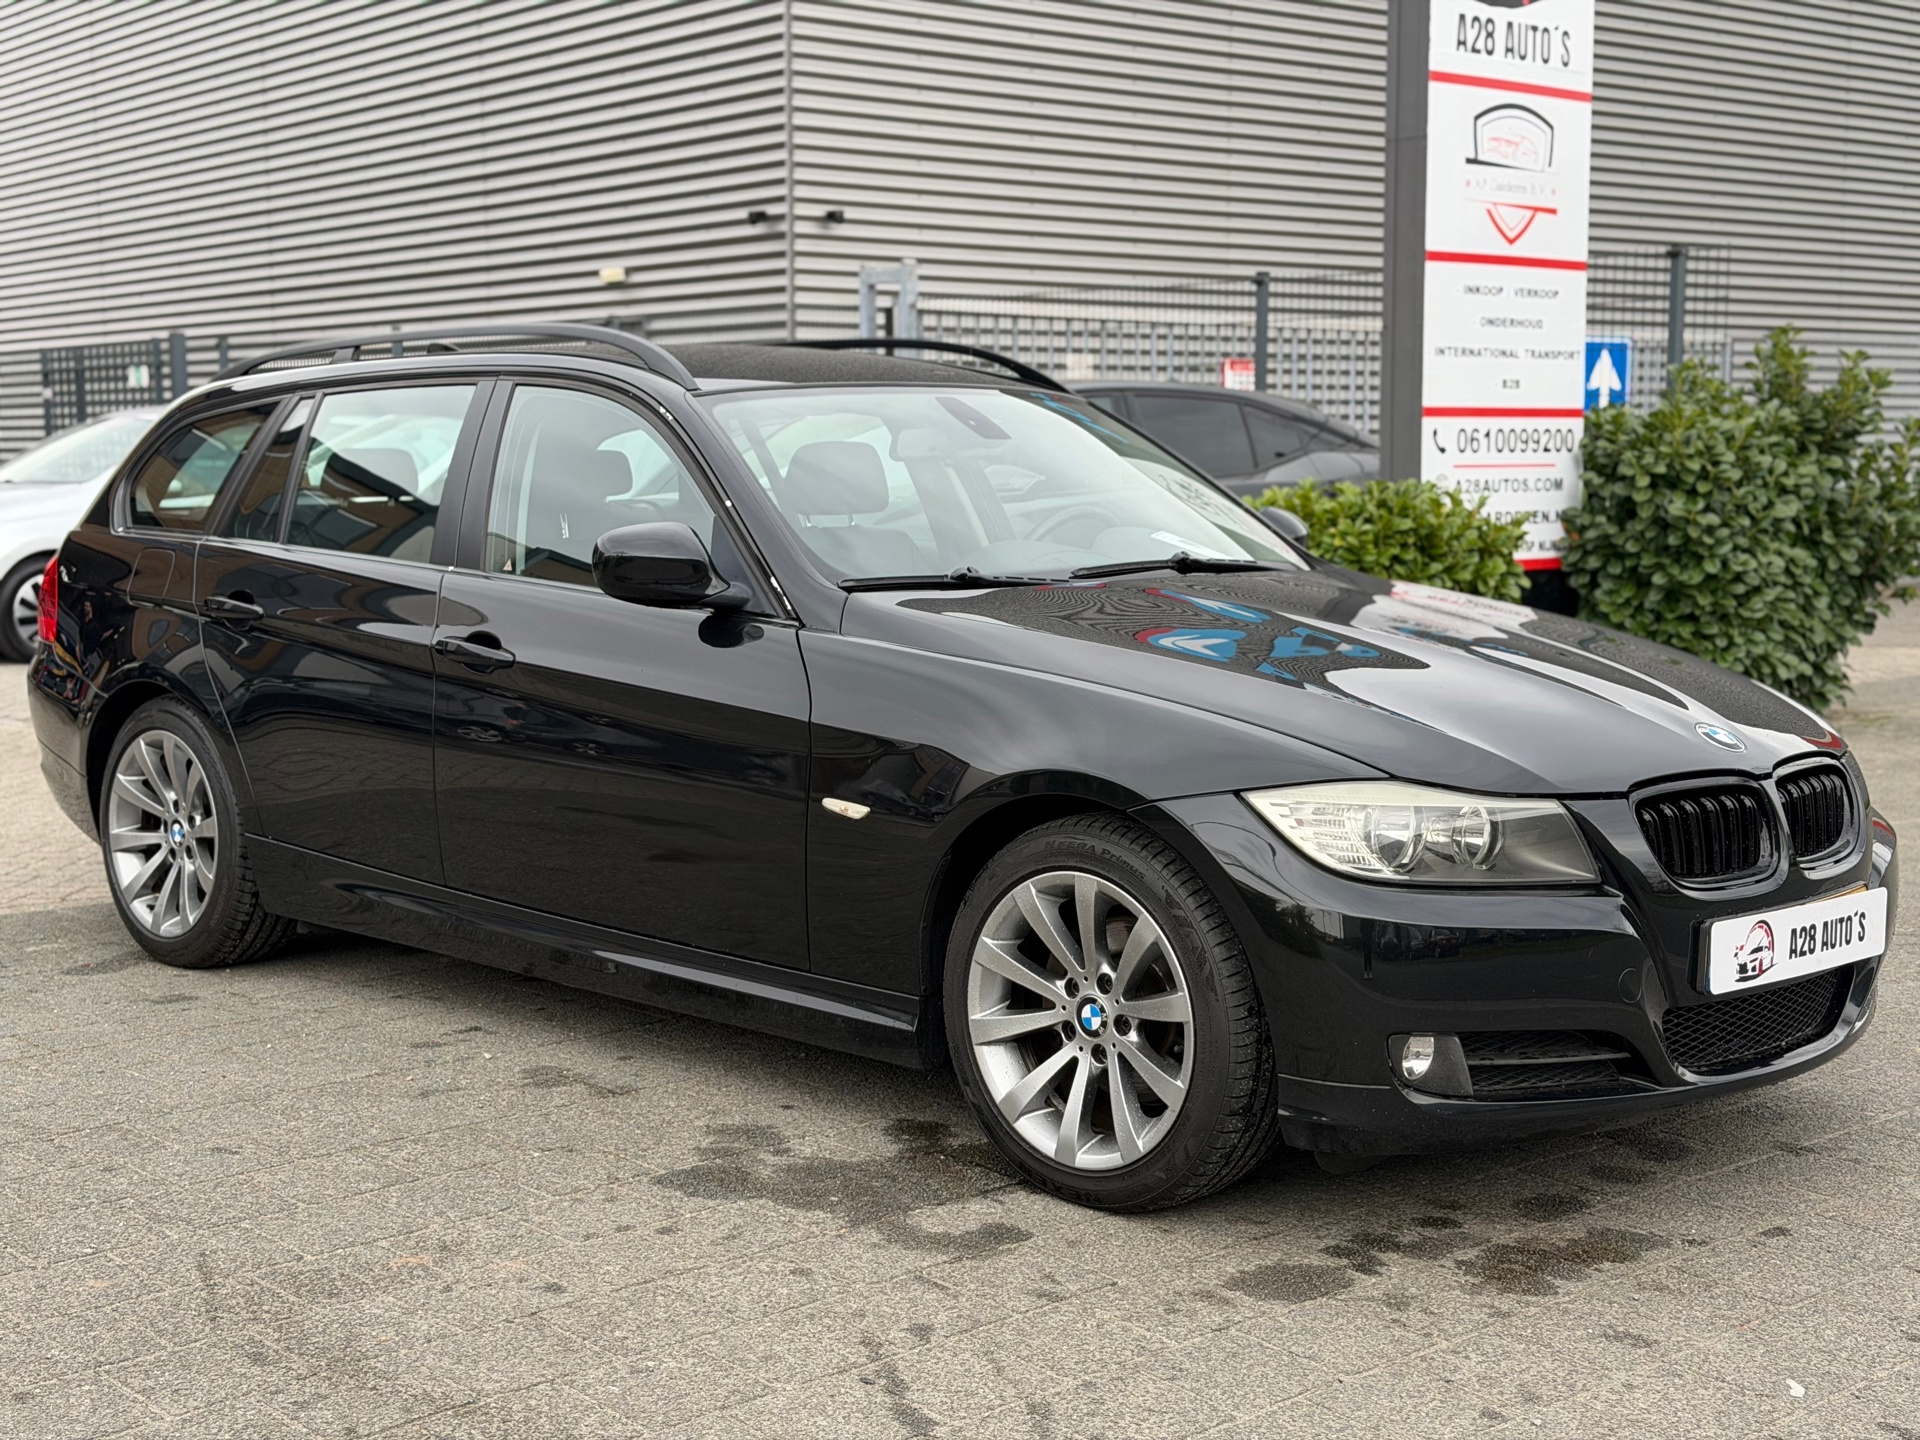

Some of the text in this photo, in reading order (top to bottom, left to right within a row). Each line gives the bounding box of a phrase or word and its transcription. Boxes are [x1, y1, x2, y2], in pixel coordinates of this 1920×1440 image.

[1456, 13, 1496, 56] A28
[1463, 285, 1560, 299] INKOOP VERKOOP
[1480, 316, 1544, 329] ONDERHOUD
[1435, 346, 1581, 361] INTERNATIONAL TRANSPORT
[1502, 379, 1521, 389] B2B
[1457, 428, 1575, 454] 0610099200
[1455, 478, 1563, 494] A28AUTOS.COM
[1100, 847, 1146, 880] Primus
[1789, 922, 1816, 960] A28
